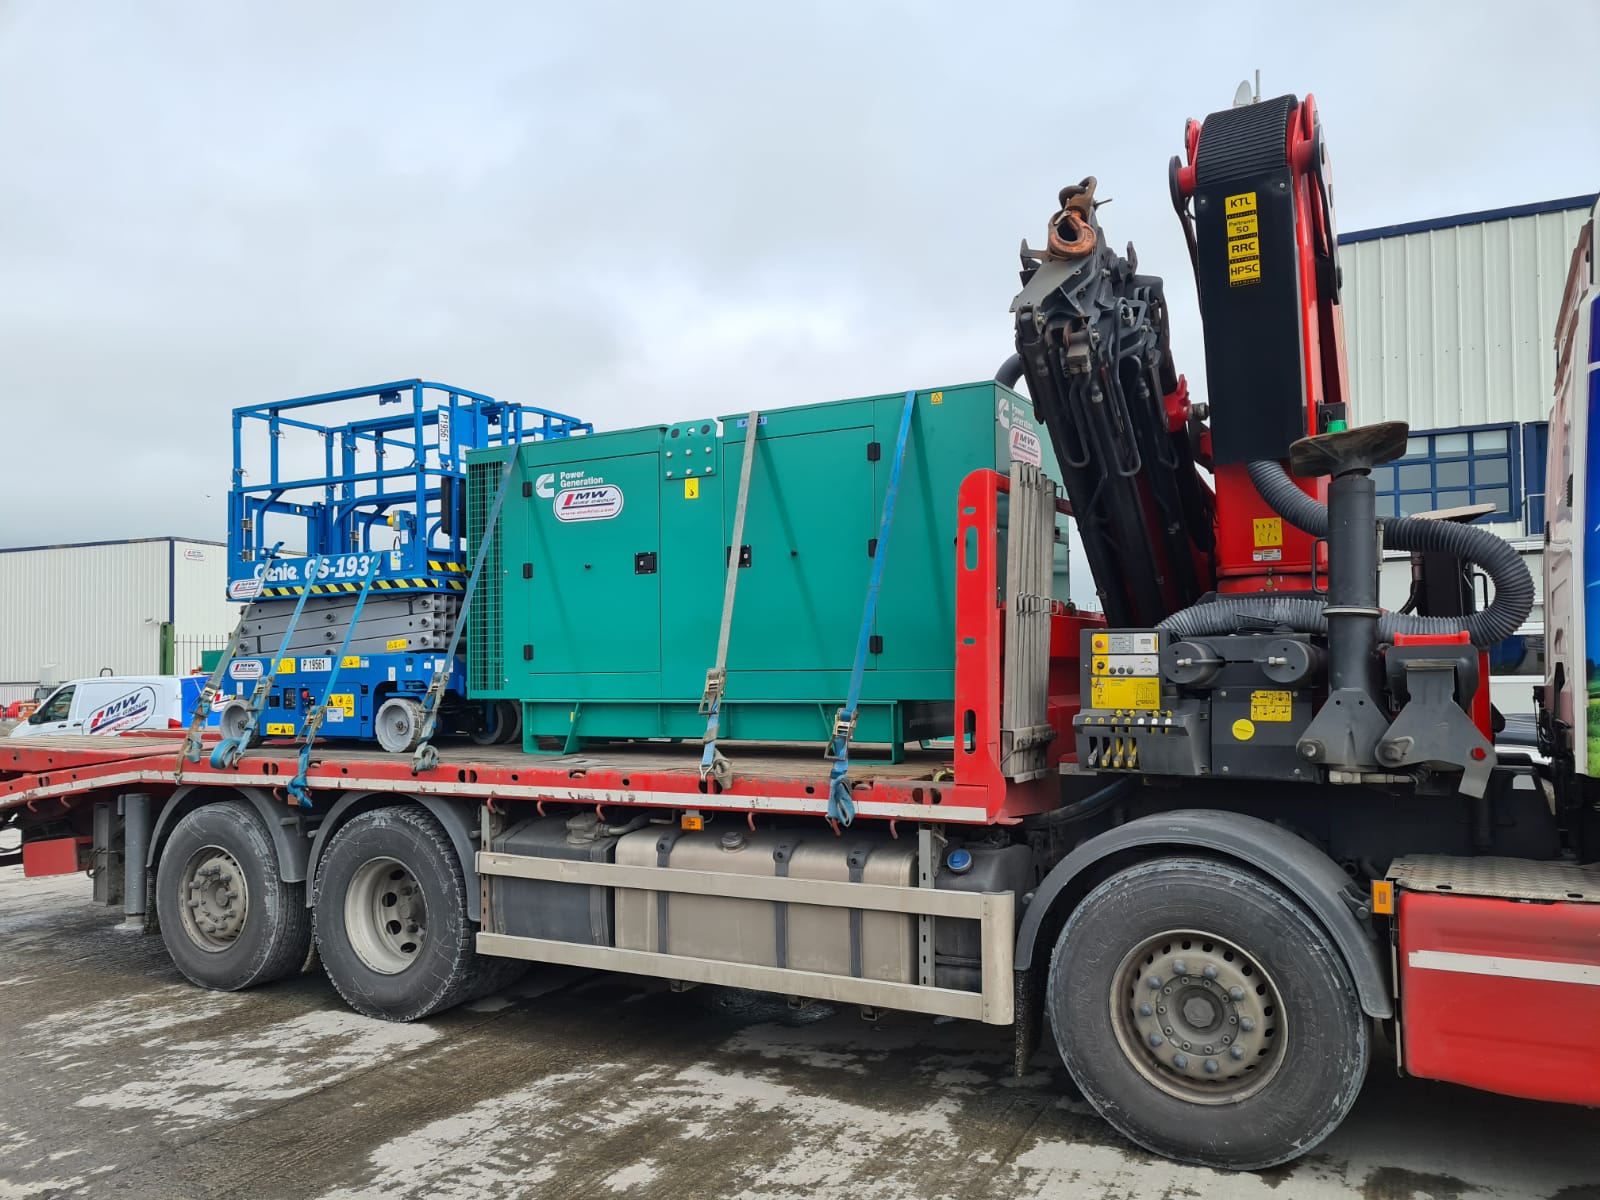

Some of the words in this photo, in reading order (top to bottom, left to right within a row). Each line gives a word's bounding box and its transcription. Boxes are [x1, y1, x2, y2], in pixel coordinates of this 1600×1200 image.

[1230, 197, 1251, 208] KTL
[1231, 241, 1255, 253] RRC
[1230, 263, 1259, 275] HPSC
[560, 471, 584, 479] Power
[560, 476, 604, 487] Generation
[575, 490, 608, 499] MW
[253, 562, 298, 582] Genie
[105, 693, 141, 717] MW
